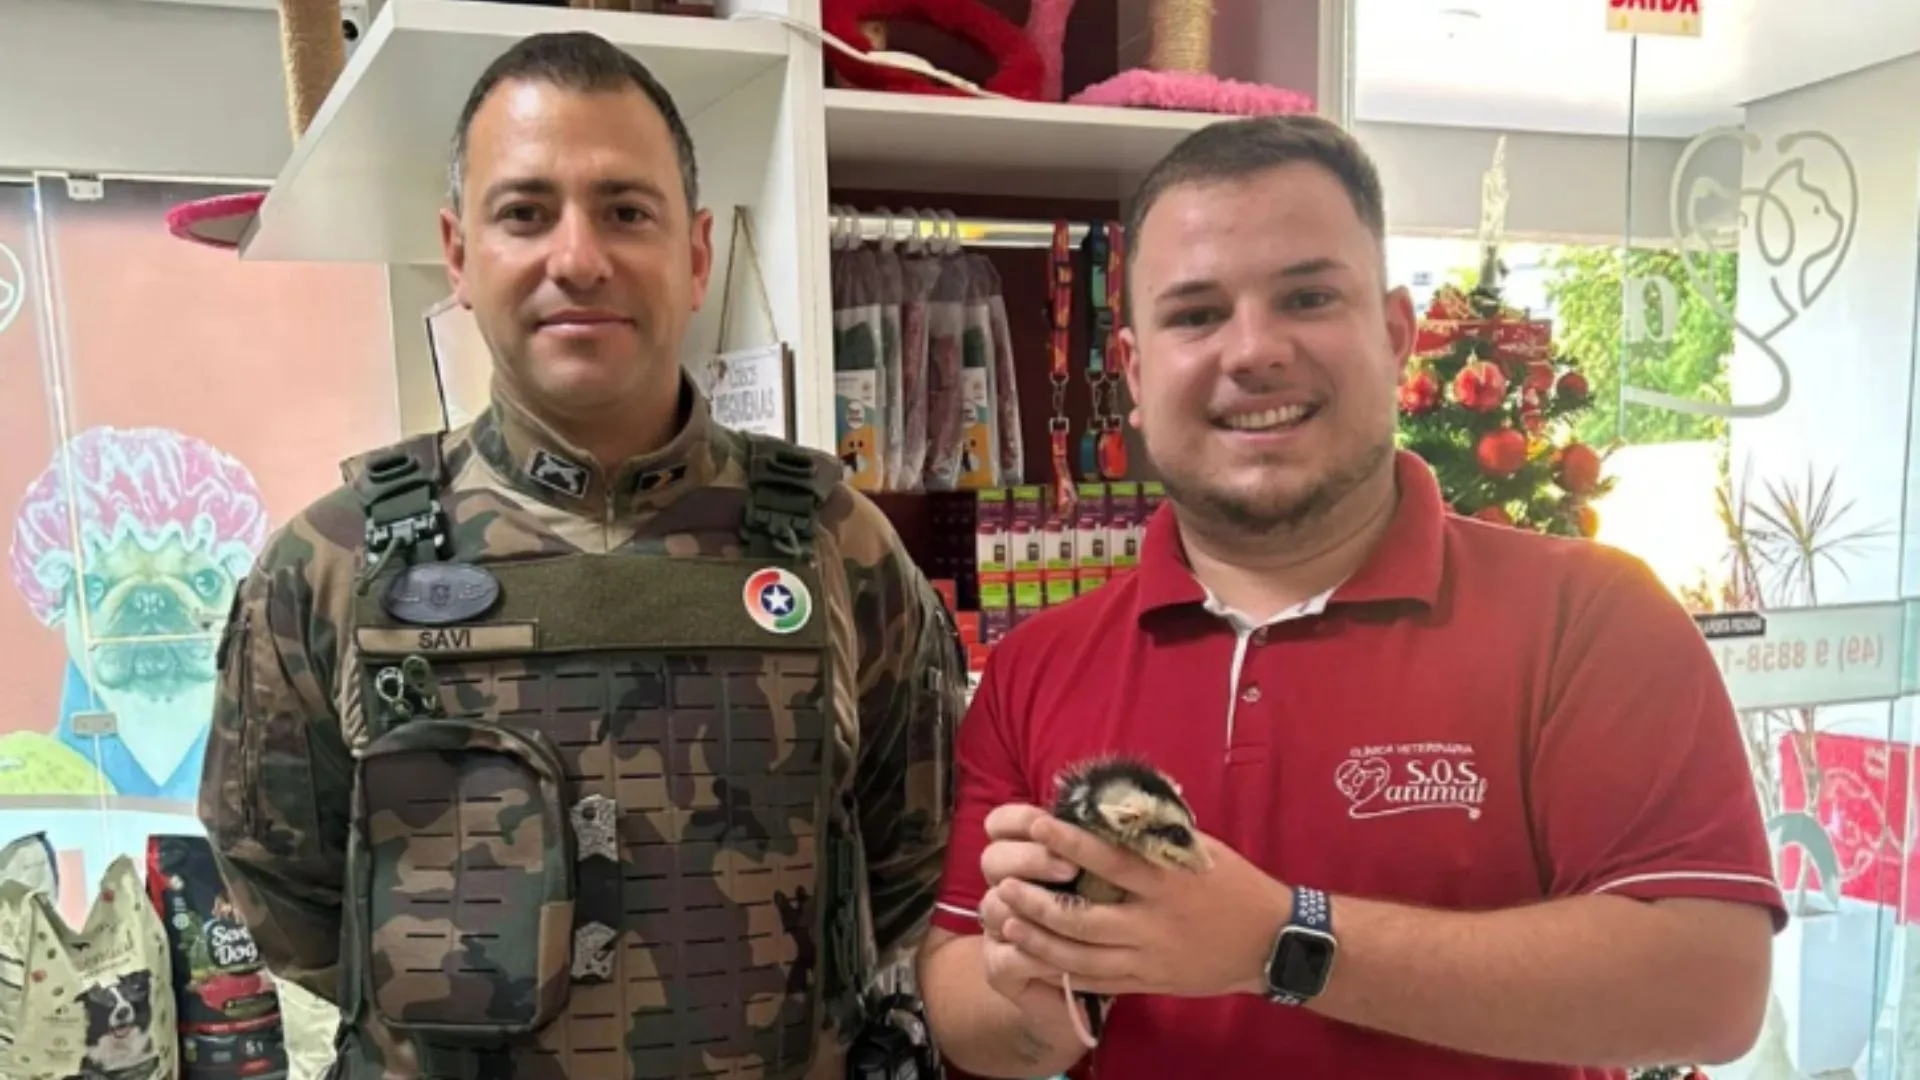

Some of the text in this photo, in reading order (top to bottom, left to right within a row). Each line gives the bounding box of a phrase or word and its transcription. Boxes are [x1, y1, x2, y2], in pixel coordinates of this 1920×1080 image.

[418, 629, 471, 650] SAVI
[1384, 777, 1488, 803] animal
[214, 942, 259, 966] Dog
